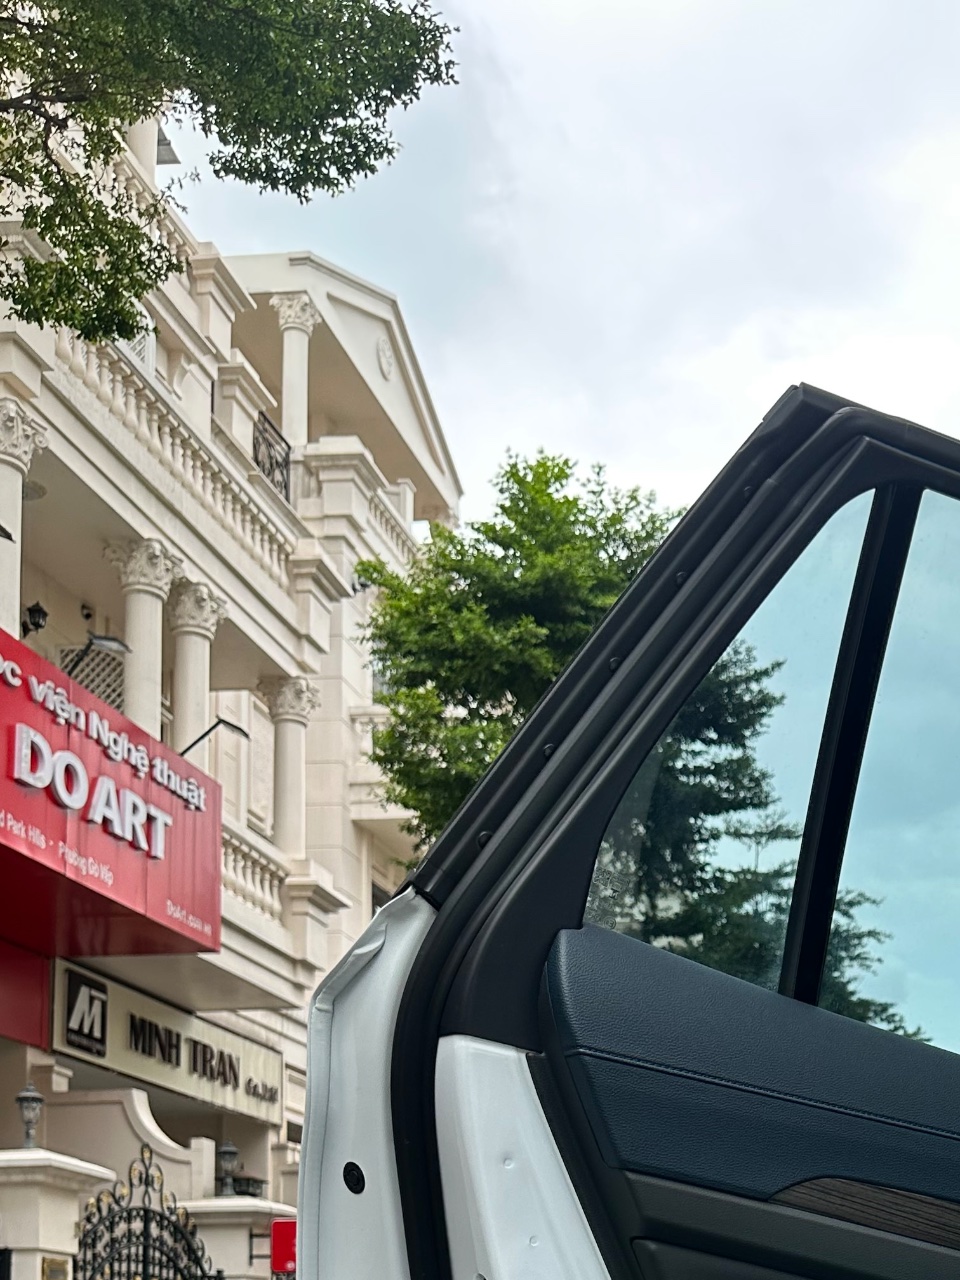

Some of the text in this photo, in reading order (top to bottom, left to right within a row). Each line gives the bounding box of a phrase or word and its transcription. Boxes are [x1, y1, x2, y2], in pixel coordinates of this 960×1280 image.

[14, 722, 173, 860] DO ART
[28, 675, 86, 731] viện
[88, 710, 150, 779] Nghệ
[151, 756, 207, 811] thuật
[129, 1013, 182, 1068] MINH
[185, 1037, 241, 1091] TRAN
